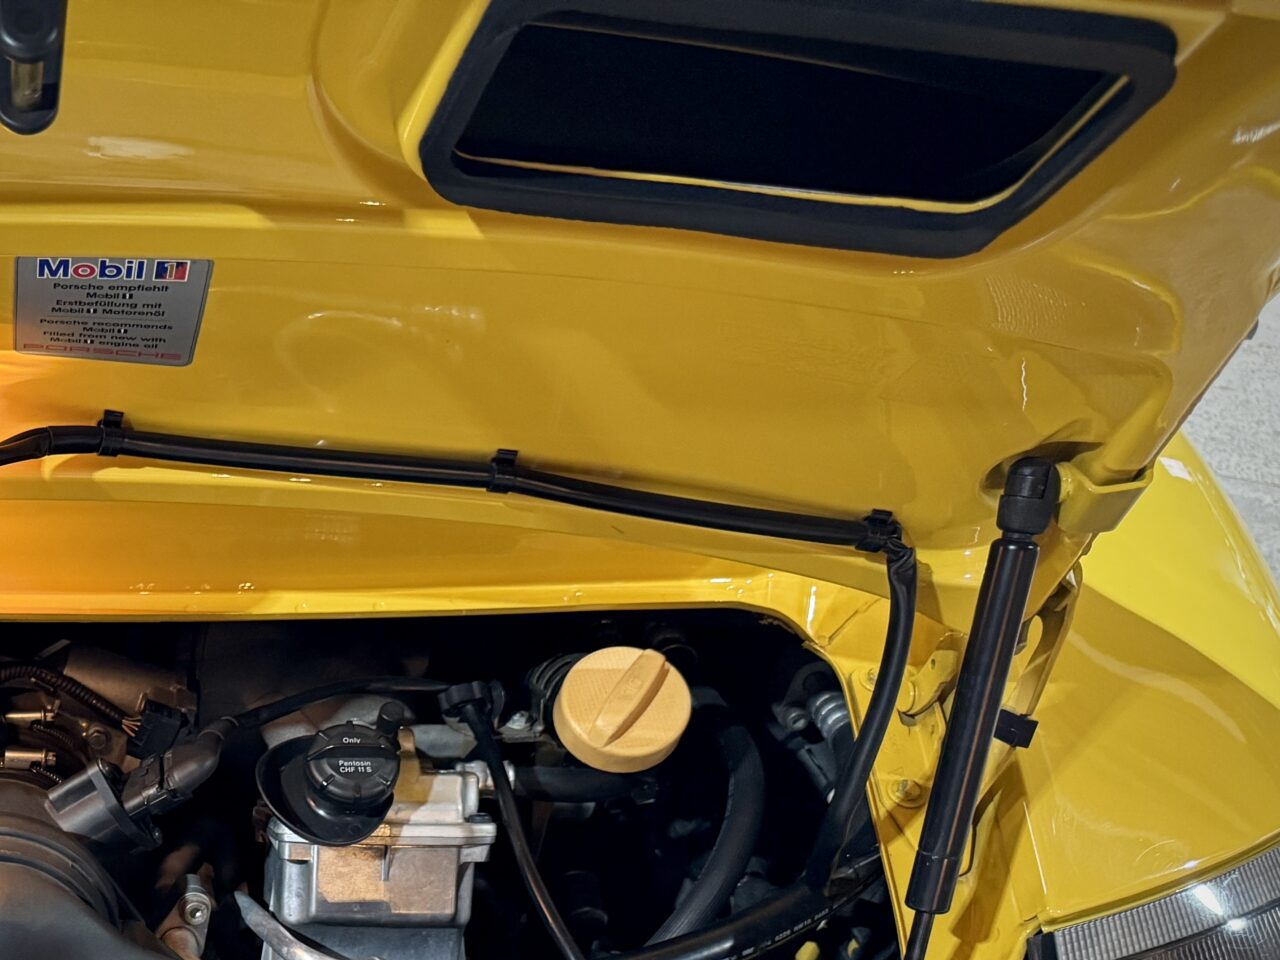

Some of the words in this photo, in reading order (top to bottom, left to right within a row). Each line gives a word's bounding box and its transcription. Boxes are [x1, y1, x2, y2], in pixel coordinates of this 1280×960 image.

[36, 257, 147, 281] Mobil
[53, 282, 104, 292] Porsche
[108, 284, 169, 293] empfiehlt
[86, 292, 120, 300] Mobil
[56, 299, 138, 309] Erstbefüllung
[102, 308, 165, 317] Motorenöl
[40, 318, 88, 326] Porsche
[92, 320, 173, 330] recommends
[78, 332, 107, 340] from
[98, 340, 140, 348] engine
[23, 343, 182, 361] PORSCHE
[342, 736, 361, 744] Only
[338, 759, 372, 767] Pentosin
